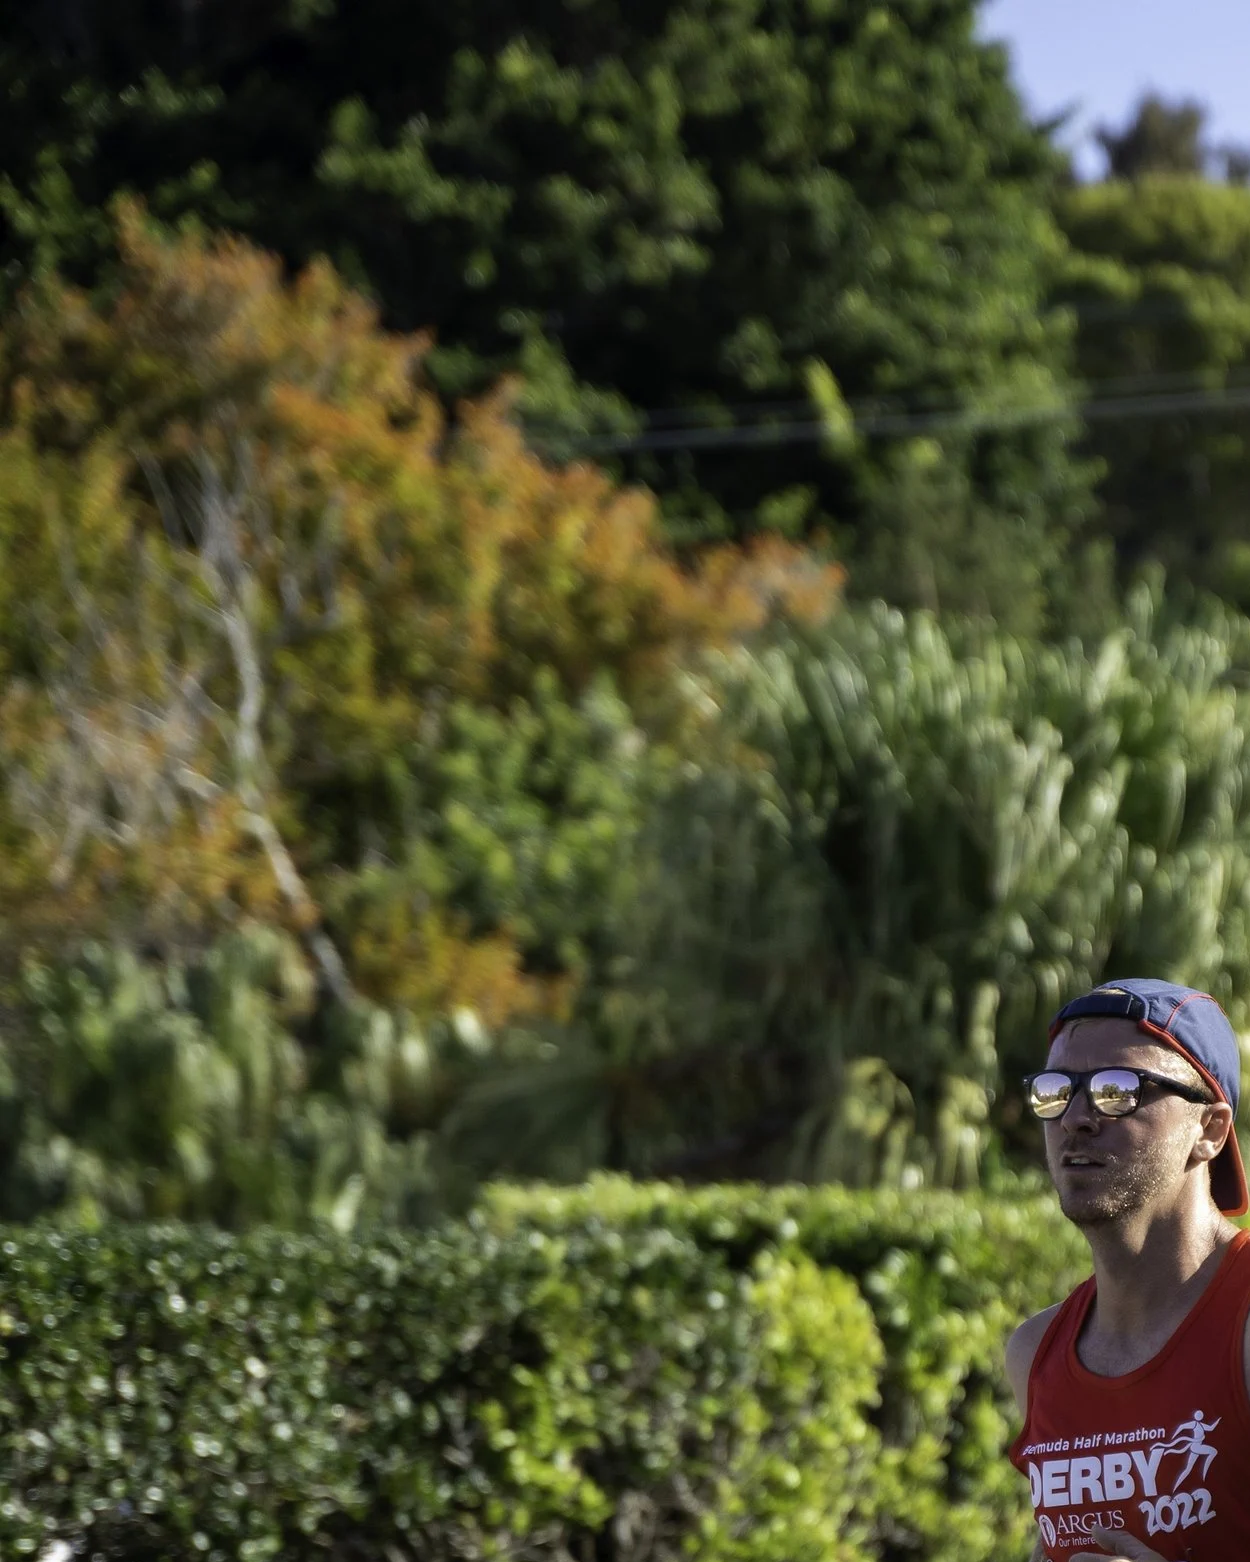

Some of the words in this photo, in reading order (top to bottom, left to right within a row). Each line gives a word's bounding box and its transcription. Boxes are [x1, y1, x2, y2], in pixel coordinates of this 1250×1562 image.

[1022, 1438, 1070, 1456] Bermuda
[1074, 1433, 1102, 1450] Half
[1104, 1427, 1166, 1445] Marathon
[1029, 1448, 1166, 1509] DERBY
[1057, 1509, 1125, 1535] ARGUS
[1138, 1488, 1216, 1537] 2022
[1058, 1538, 1071, 1548] Our
[1072, 1536, 1097, 1546] Intere
